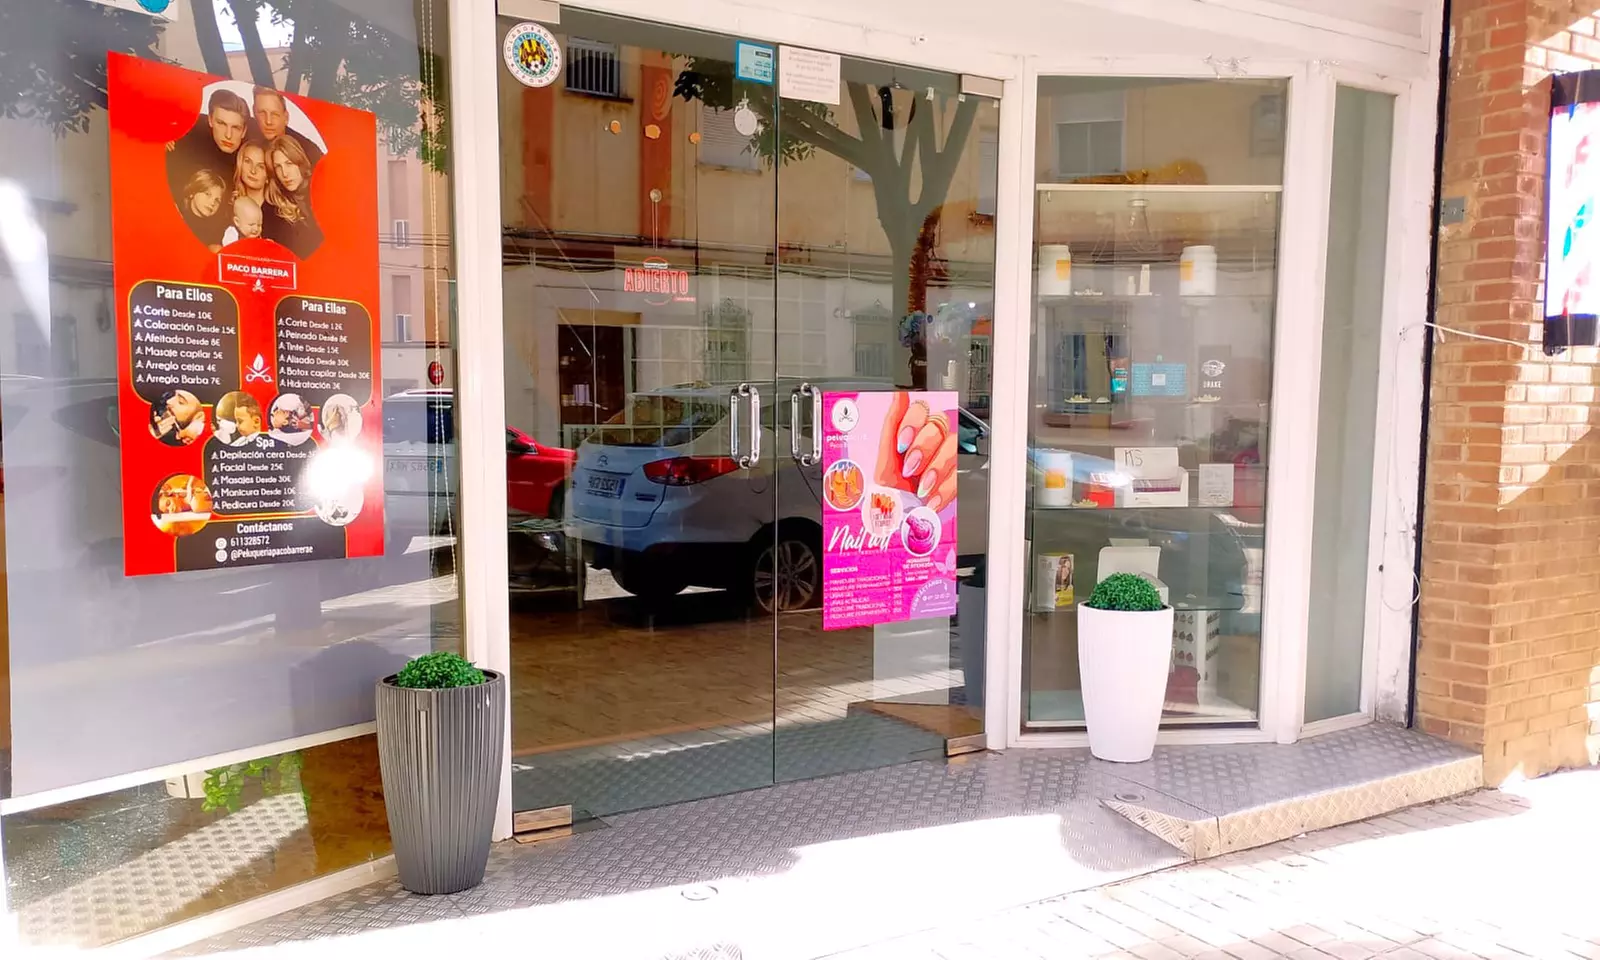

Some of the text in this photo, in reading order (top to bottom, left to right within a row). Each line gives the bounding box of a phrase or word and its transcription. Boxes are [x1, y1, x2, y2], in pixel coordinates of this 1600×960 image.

[227, 263, 250, 273] PACO
[251, 266, 289, 278] BARRERA
[623, 267, 689, 296] ABIERTO
[156, 285, 213, 302] Para Ellos
[143, 305, 212, 320] Corte Desde 10€
[302, 300, 347, 315] Para Ellas
[144, 319, 236, 335] Coloración Desde 15€
[285, 317, 308, 328] Corte
[309, 320, 329, 330] Desde
[144, 333, 184, 345] Afeitada
[186, 337, 209, 346] Desde
[285, 330, 318, 341] Peinado
[319, 334, 338, 342] Desde
[144, 346, 178, 358] Masaje
[179, 348, 211, 360] capilar
[286, 342, 304, 352] Tinte
[305, 345, 326, 354] Desde
[145, 360, 217, 373] Arreglo cejas 4€
[286, 355, 315, 365] Alisado
[316, 358, 336, 366] Desde
[146, 373, 221, 386] Arreglo Barba 7€
[286, 367, 309, 377] Botox
[310, 369, 337, 379] capilar
[338, 371, 357, 379] Desde
[286, 379, 331, 390] Hidratación
[256, 436, 275, 450] Spa
[220, 450, 265, 460] Depilación
[286, 451, 307, 459] Desde
[220, 463, 246, 472] Facial
[247, 463, 269, 471] Desde
[220, 475, 254, 485] Masajes
[255, 475, 277, 483] Desde
[221, 488, 259, 497] Manicura
[260, 487, 282, 496] Desde
[221, 500, 258, 510] Pedicura
[259, 499, 280, 508] Desde
[236, 522, 294, 534] Contáctanos
[230, 536, 270, 547] 611328572
[827, 525, 867, 556] Nail
